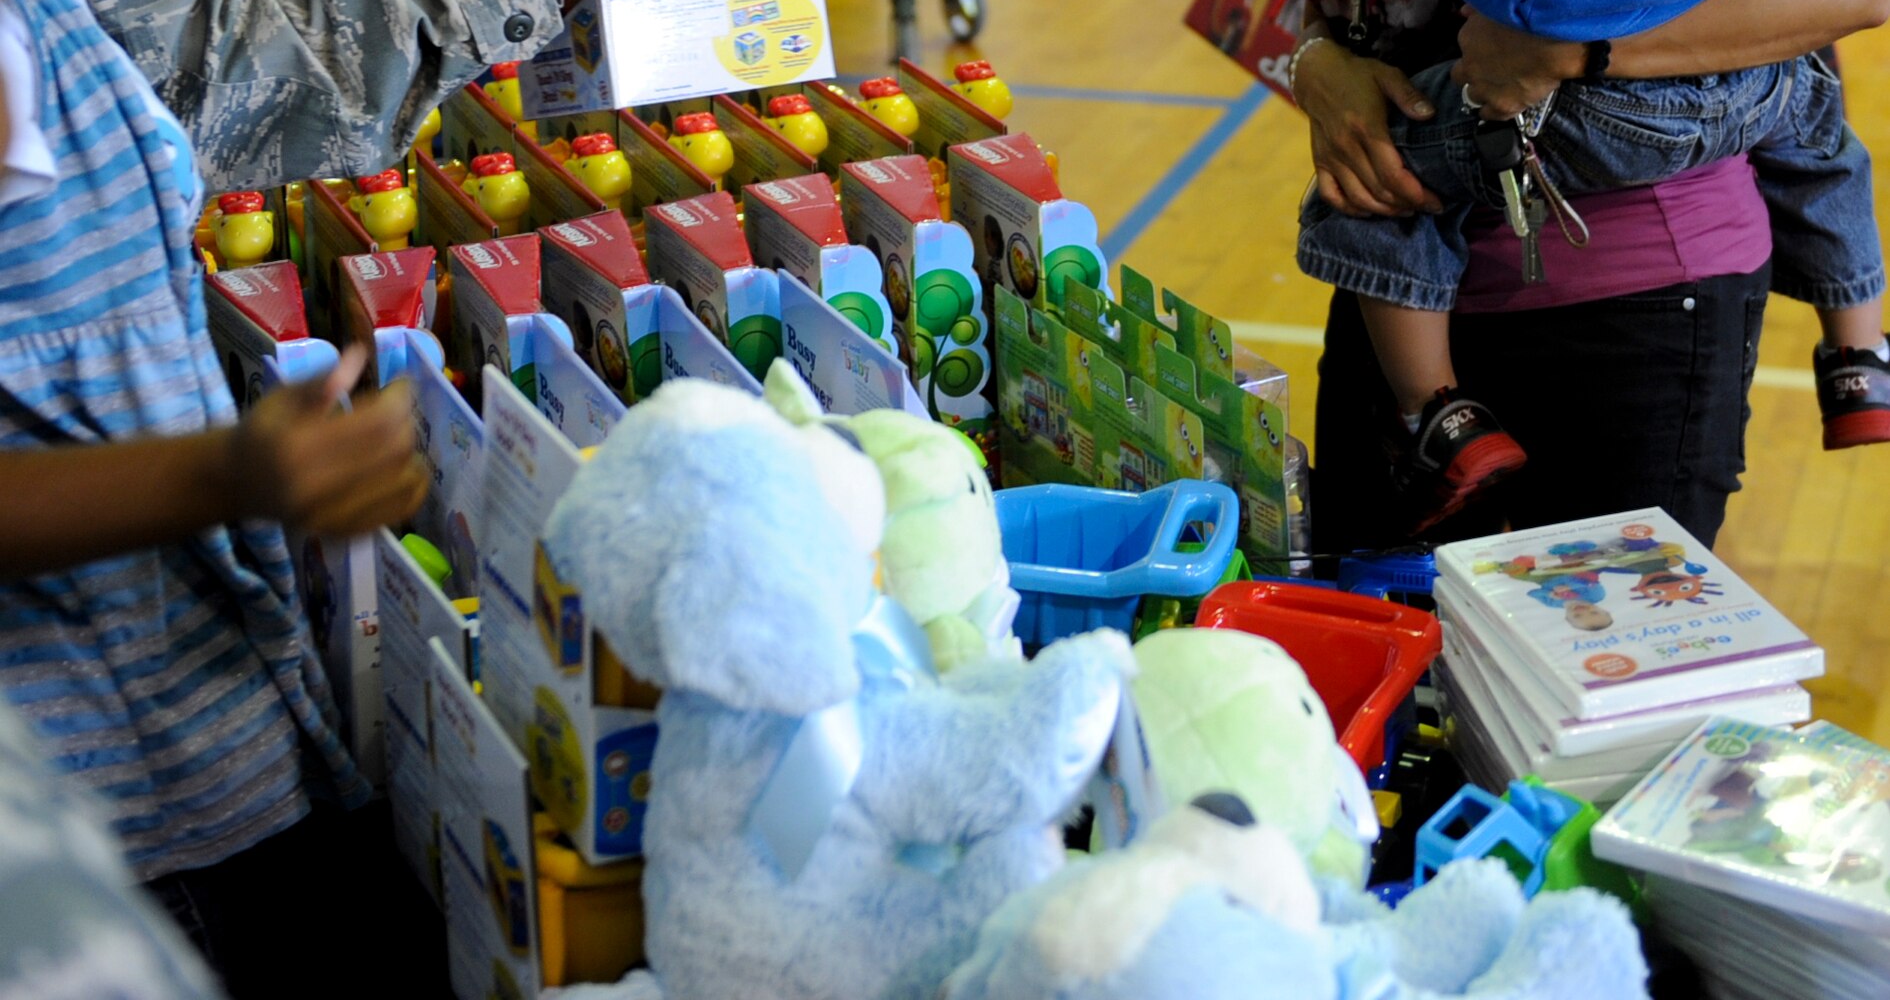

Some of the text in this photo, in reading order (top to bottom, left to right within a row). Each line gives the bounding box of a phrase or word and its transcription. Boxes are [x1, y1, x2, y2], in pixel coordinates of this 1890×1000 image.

[786, 323, 817, 372] Busy
[1834, 375, 1870, 393] SKX
[539, 371, 565, 424] Busy
[1441, 407, 1476, 432] SKX
[1688, 619, 1702, 628] a
[1709, 614, 1729, 626] in
[1734, 608, 1762, 622] all
[1572, 634, 1620, 651] play
[1625, 624, 1682, 643] day's
